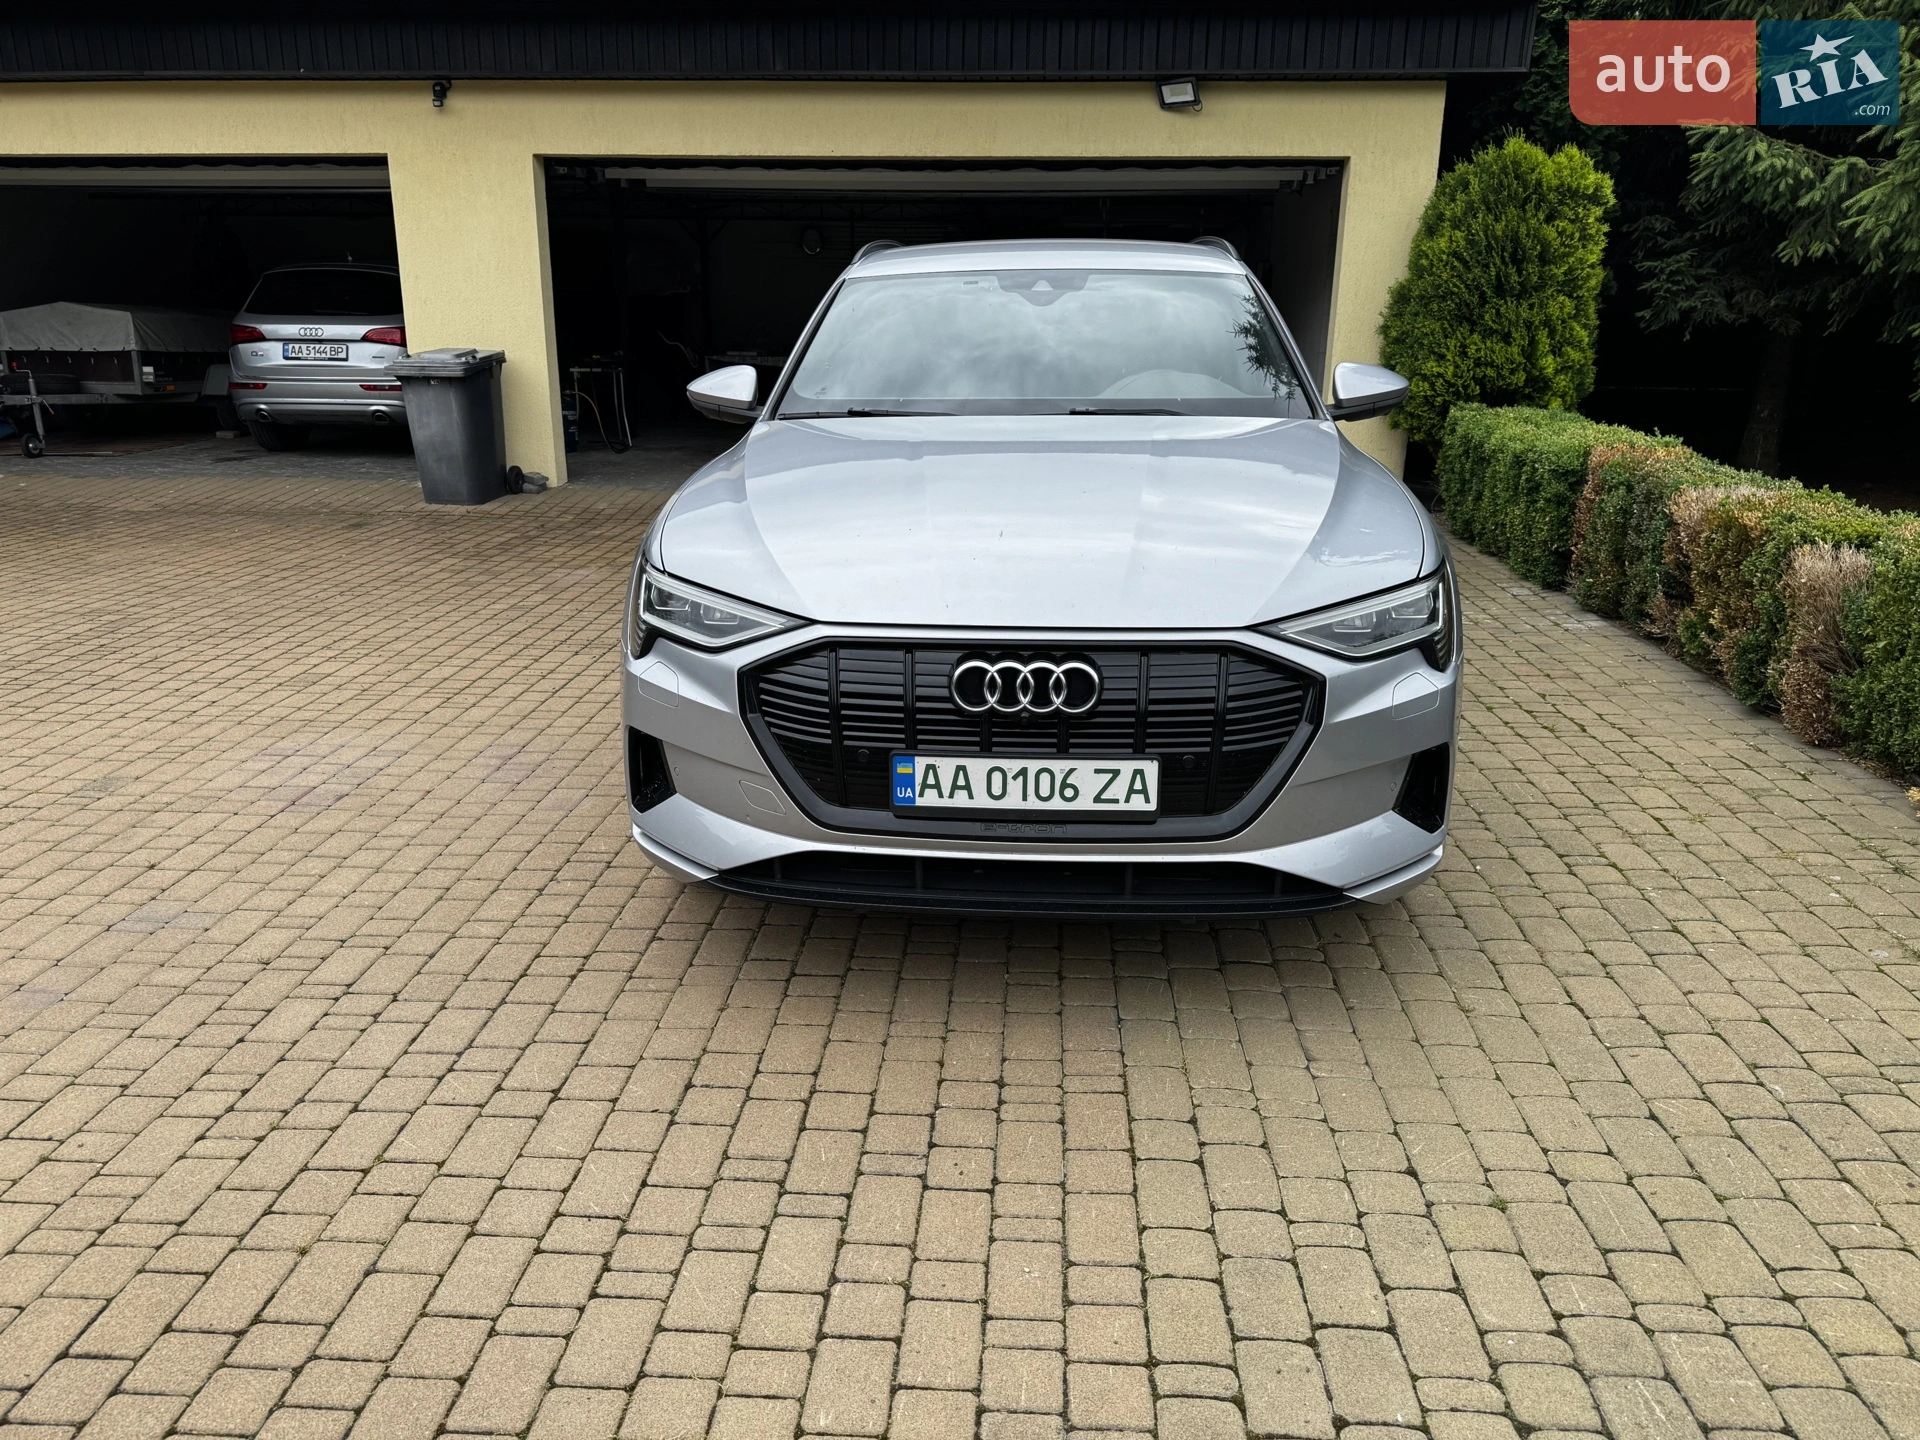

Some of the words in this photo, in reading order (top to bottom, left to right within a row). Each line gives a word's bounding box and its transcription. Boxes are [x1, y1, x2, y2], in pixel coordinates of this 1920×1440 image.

[290, 345, 304, 356] AA
[305, 345, 328, 356] 5144
[330, 346, 344, 357] BP
[918, 763, 975, 800] AA
[986, 765, 1080, 803] 0106
[1093, 768, 1151, 804] ZA
[897, 786, 914, 798] UA
[980, 822, 1068, 835] e-tron
